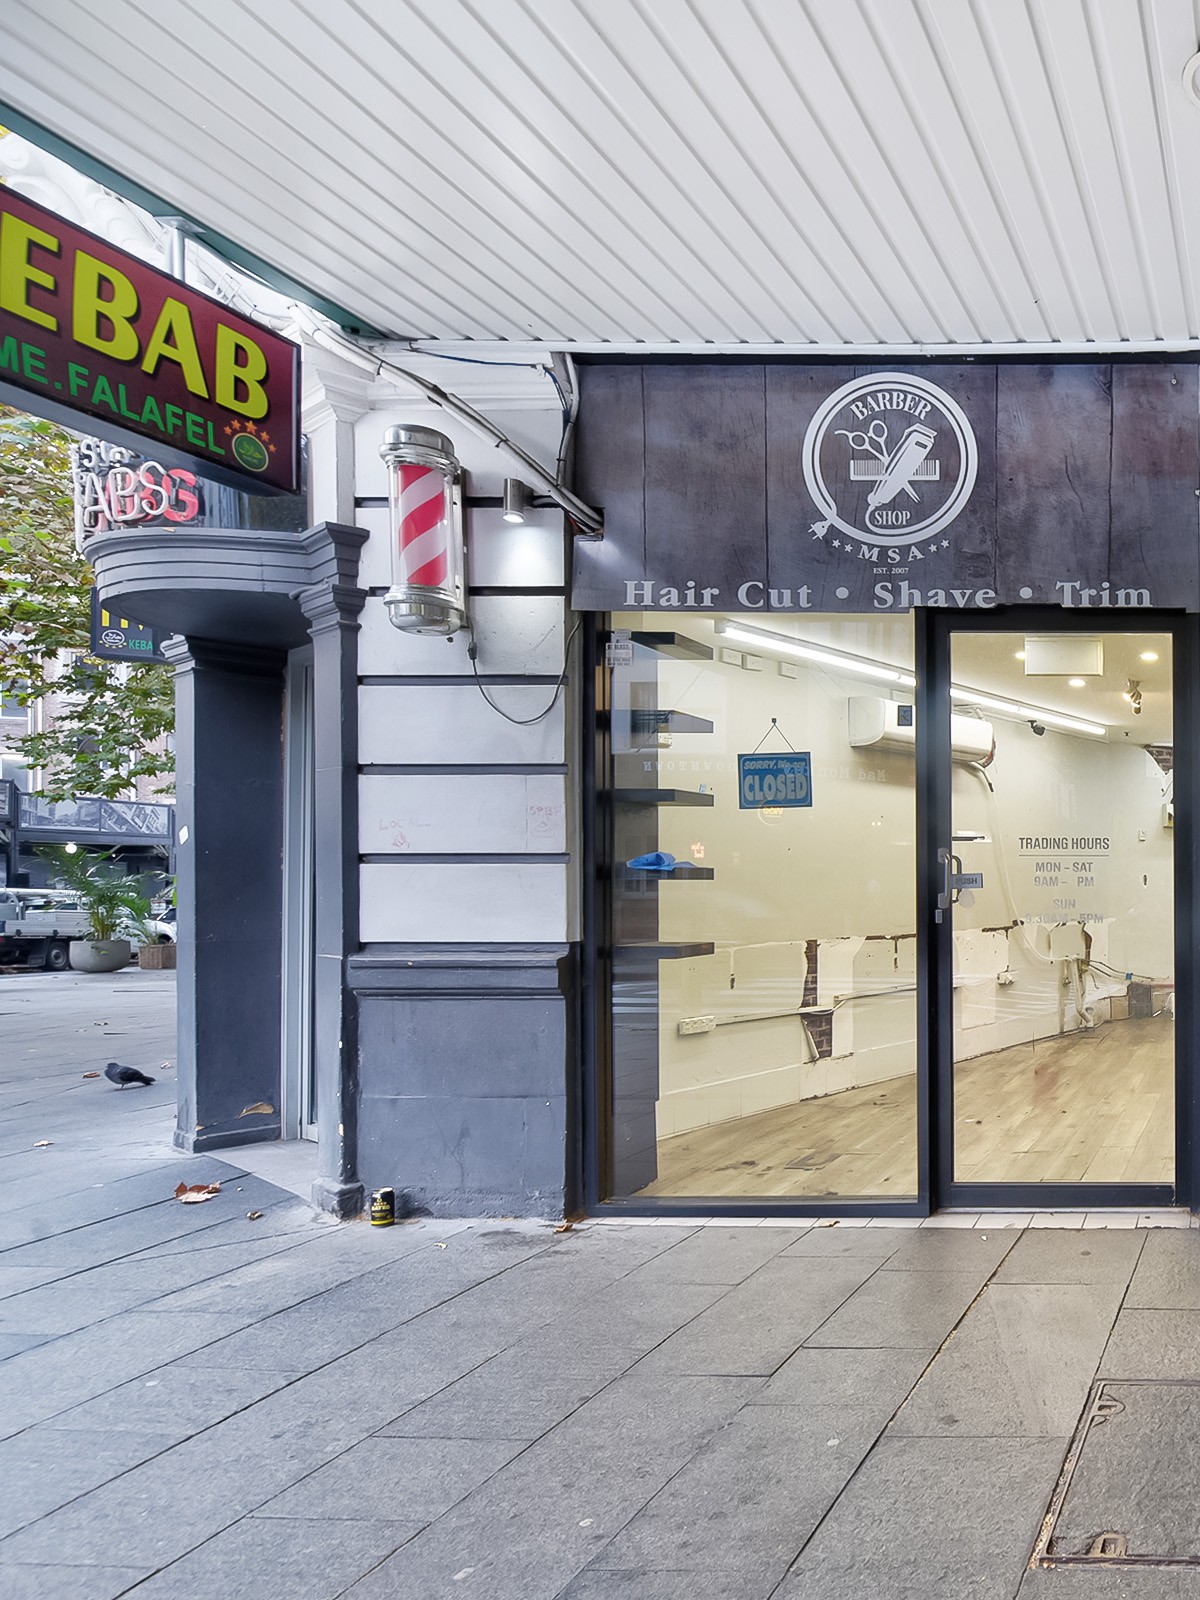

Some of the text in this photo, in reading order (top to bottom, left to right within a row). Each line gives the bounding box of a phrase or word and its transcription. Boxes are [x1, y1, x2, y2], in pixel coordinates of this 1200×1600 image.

[850, 391, 932, 420] BARBER
[874, 510, 911, 525] SHOP
[857, 544, 925, 563] MSA
[623, 580, 1153, 608] Hair Cut Shave Trim
[744, 773, 808, 801] CLOSED
[1019, 837, 1110, 850] TRADING HOURS
[1035, 862, 1060, 873] MON
[1072, 862, 1094, 873] SAT
[1034, 876, 1058, 887] 9AM
[1077, 876, 1094, 887] PM
[1053, 899, 1076, 910] SUN
